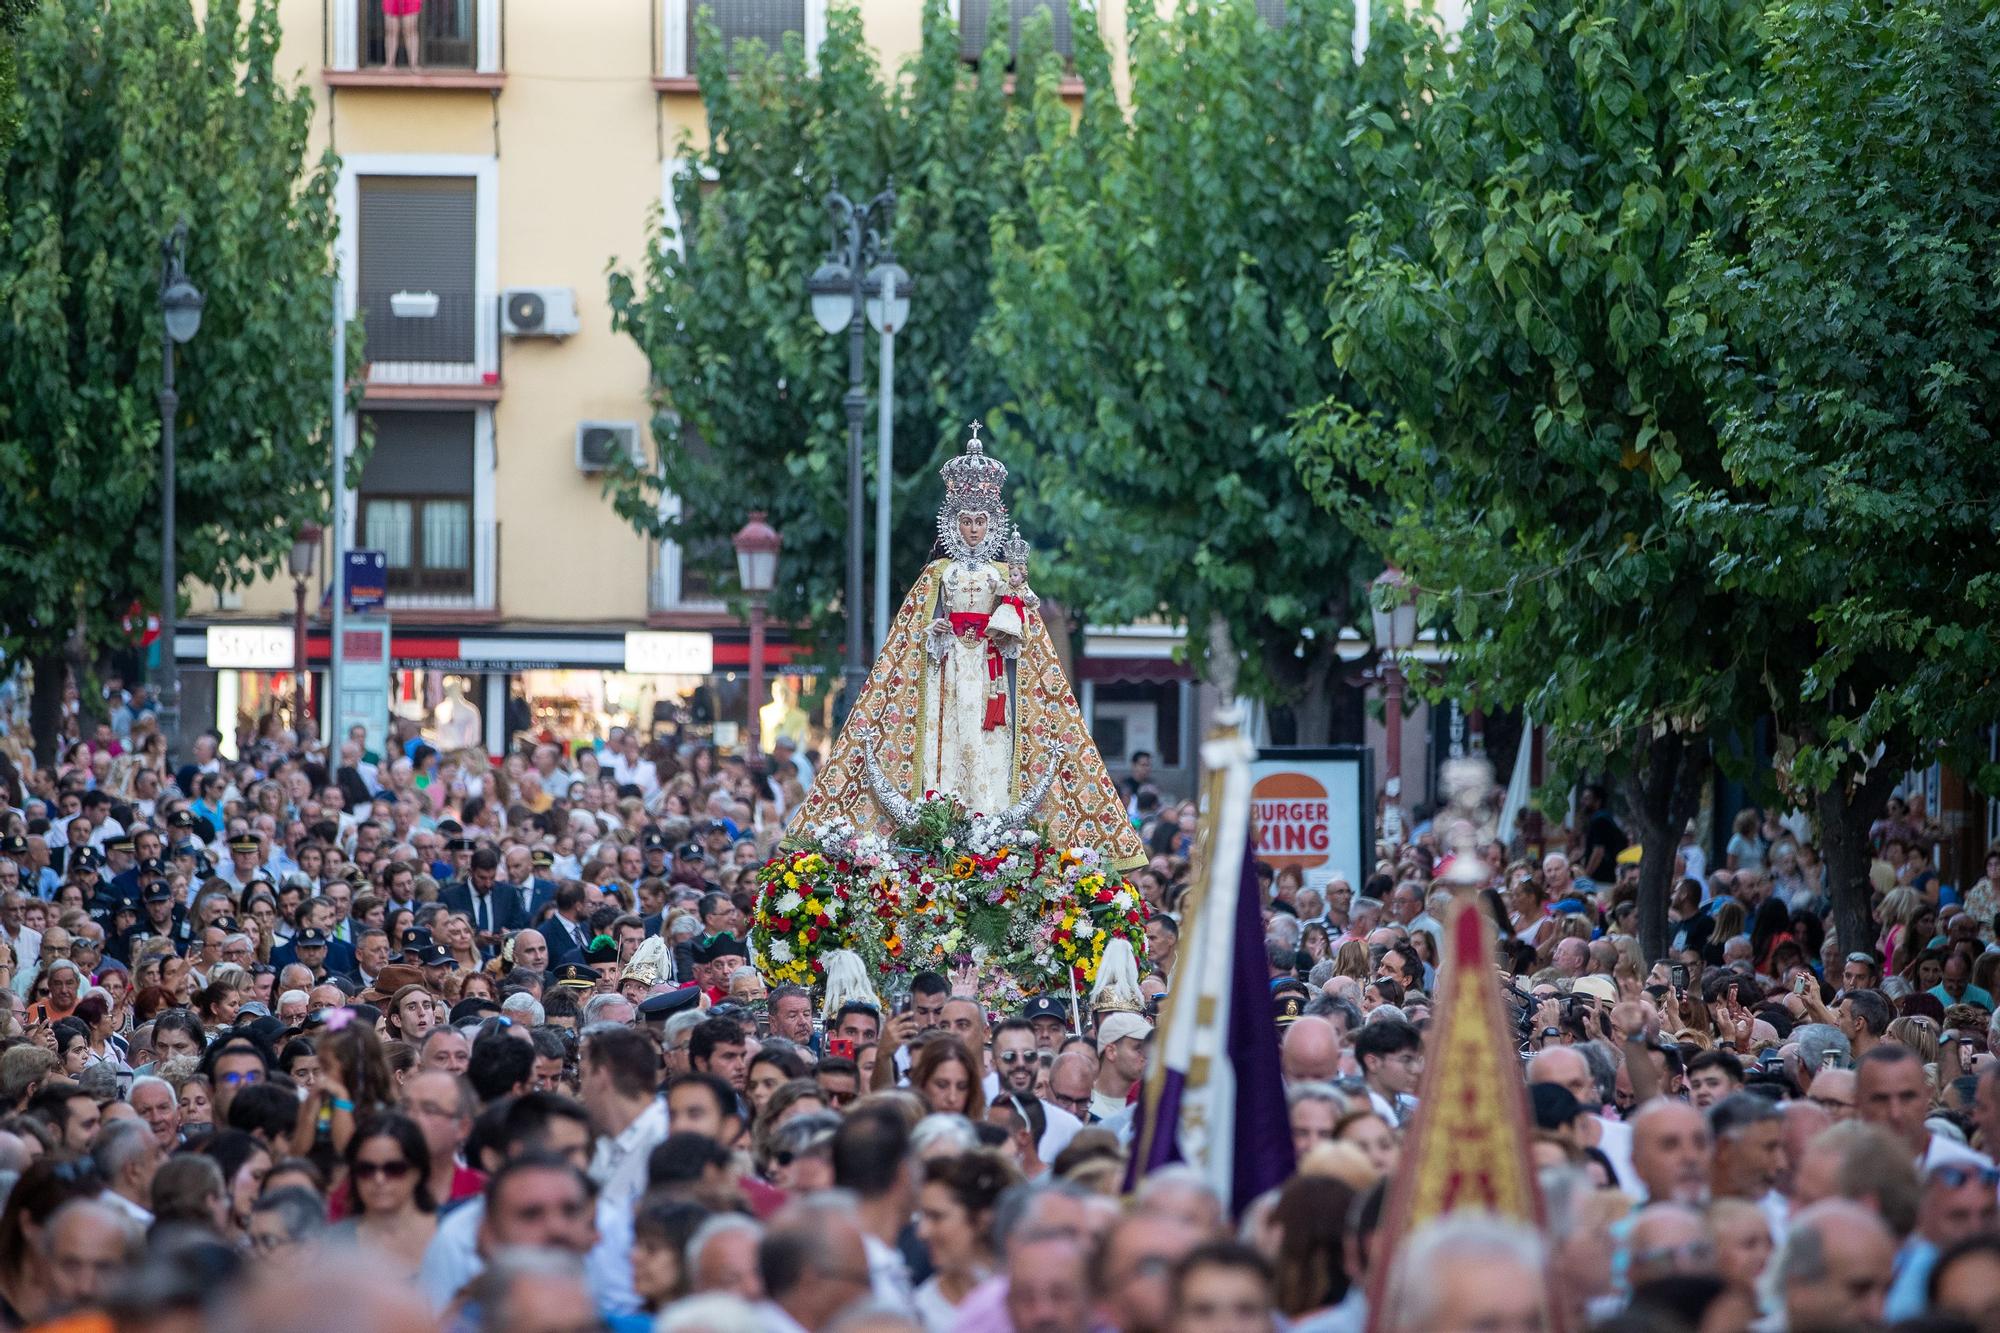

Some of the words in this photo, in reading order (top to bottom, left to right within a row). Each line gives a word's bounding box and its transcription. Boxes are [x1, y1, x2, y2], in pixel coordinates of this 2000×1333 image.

[218, 631, 284, 662] Style
[1249, 803, 1329, 821] BURGER
[1251, 824, 1329, 851] KING
